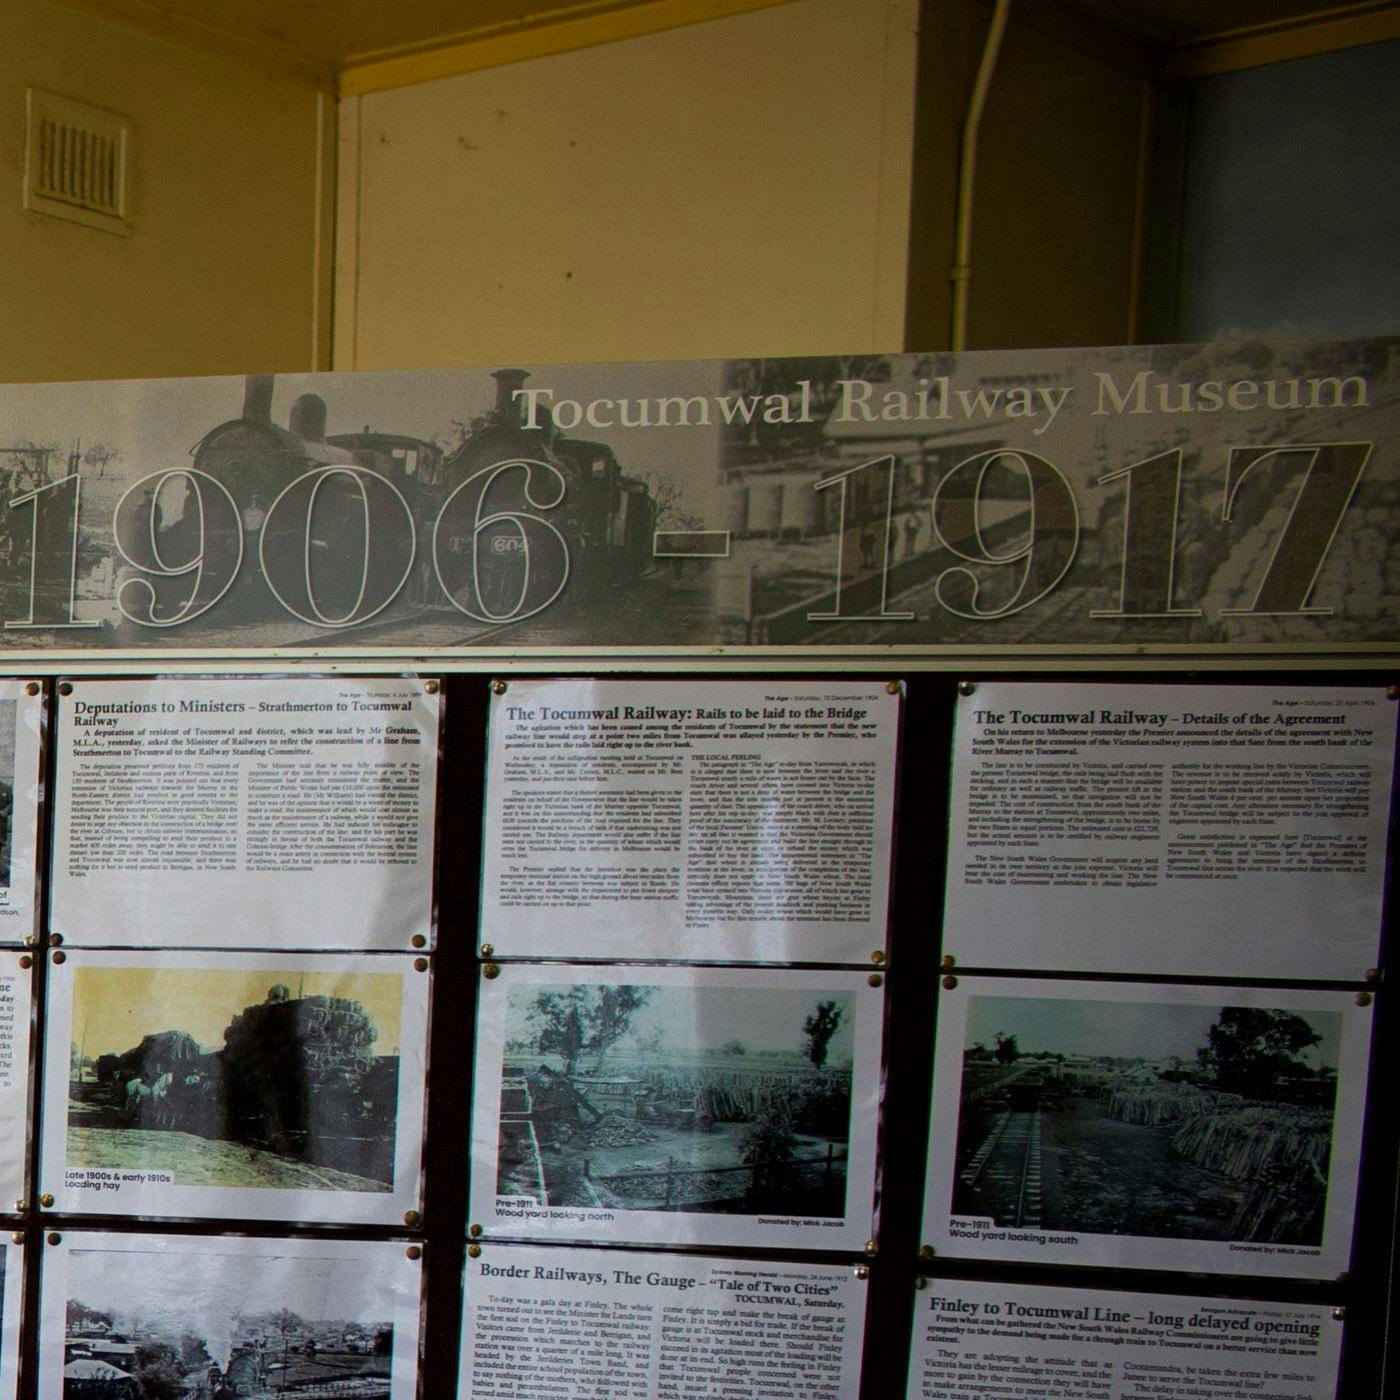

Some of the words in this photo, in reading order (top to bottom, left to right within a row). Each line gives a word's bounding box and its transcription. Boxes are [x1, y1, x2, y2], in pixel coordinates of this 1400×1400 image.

[513, 380, 814, 432] Tocumwal
[836, 377, 1073, 436] Railway
[1093, 369, 1371, 416] Museum
[4, 458, 570, 628] 1906
[806, 441, 1375, 621] 1917
[74, 701, 157, 718] Deputations
[161, 702, 176, 714] to
[179, 699, 245, 714] Ministers
[259, 701, 332, 713] Strathmerton
[335, 702, 348, 712] to
[351, 700, 412, 712] Tocumwal
[506, 707, 536, 721] The
[540, 706, 619, 721] Tocumwal
[623, 706, 692, 724] Railway:
[696, 708, 726, 719] Rails
[730, 709, 742, 719] to
[745, 708, 758, 719] be
[762, 707, 785, 718] laid
[788, 709, 801, 718] to
[805, 707, 823, 718] the
[827, 707, 867, 721] Bridge
[73, 715, 119, 729] Railway
[65, 1181, 101, 1192] Loading
[103, 1182, 120, 1192] hay
[929, 1297, 978, 1317] Finley
[983, 1302, 1000, 1315] to
[1005, 1302, 1089, 1321] Tocumwal
[1094, 1306, 1130, 1323] Line
[1148, 1310, 1184, 1330] long
[1188, 1313, 1249, 1333] delayed
[1254, 1320, 1320, 1338] opening
